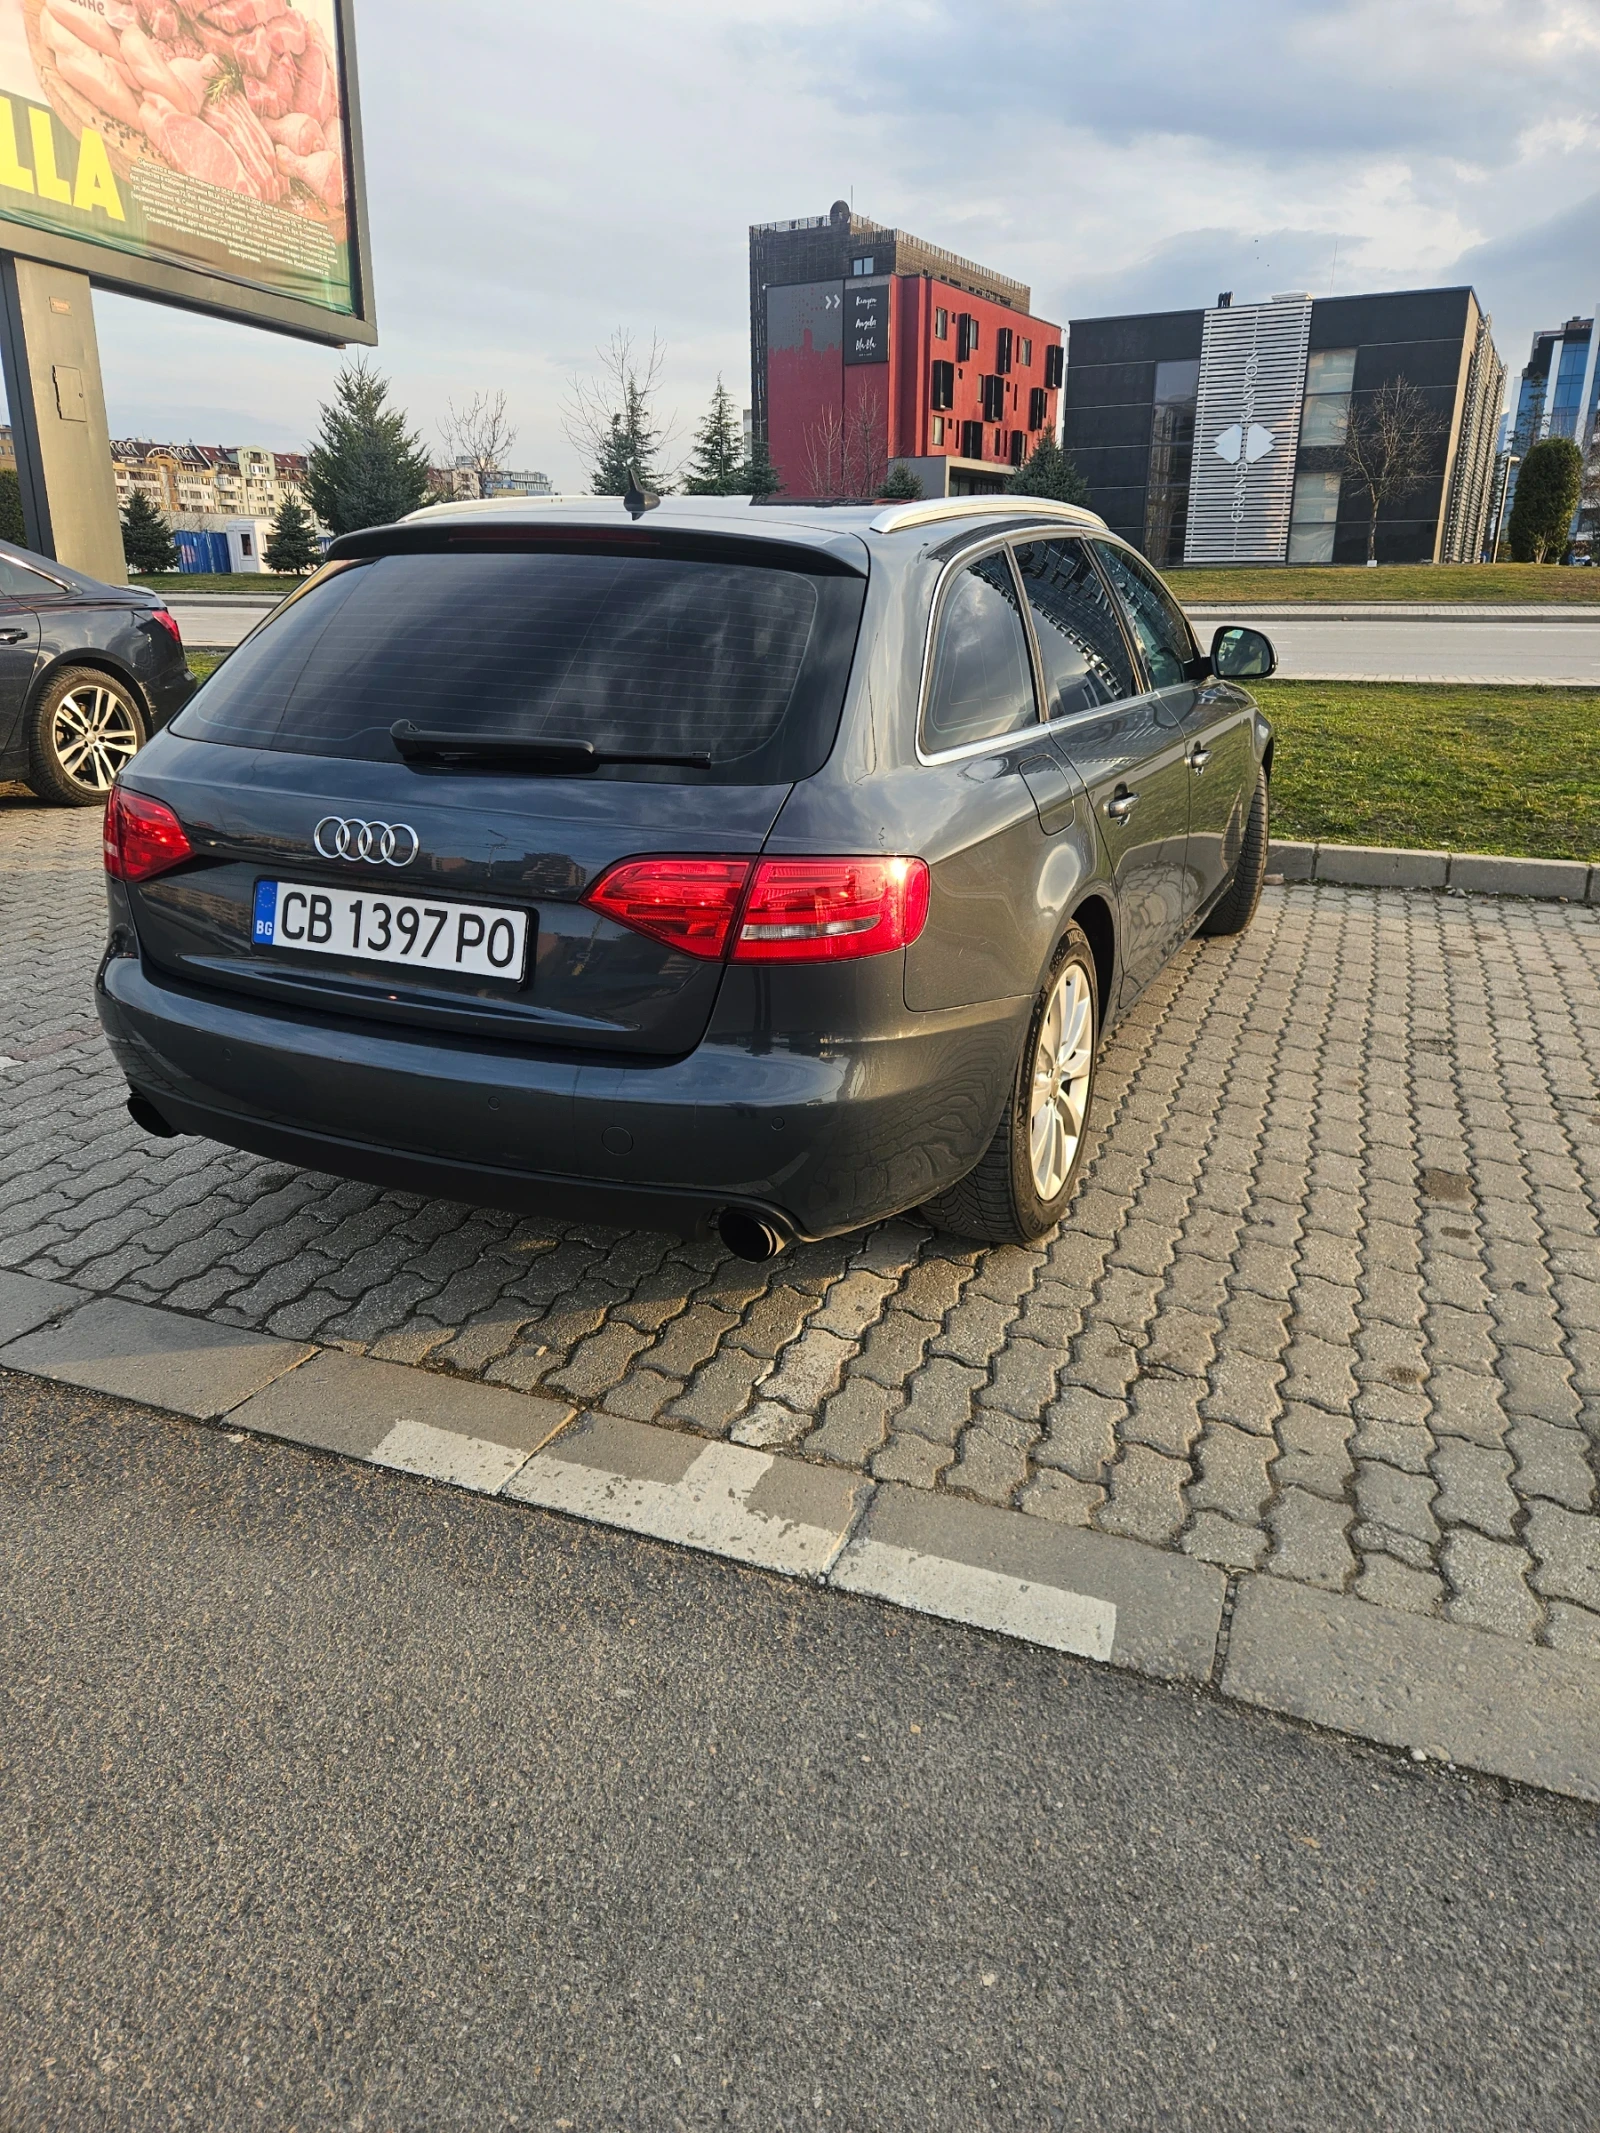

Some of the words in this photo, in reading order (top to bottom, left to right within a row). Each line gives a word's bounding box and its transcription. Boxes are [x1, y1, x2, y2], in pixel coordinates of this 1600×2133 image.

[0, 97, 126, 222] LLA
[1231, 461, 1249, 523] GRAND
[1241, 349, 1259, 424] KANYON
[255, 919, 273, 936] BG
[281, 891, 333, 944] CB
[349, 898, 448, 959] 1397
